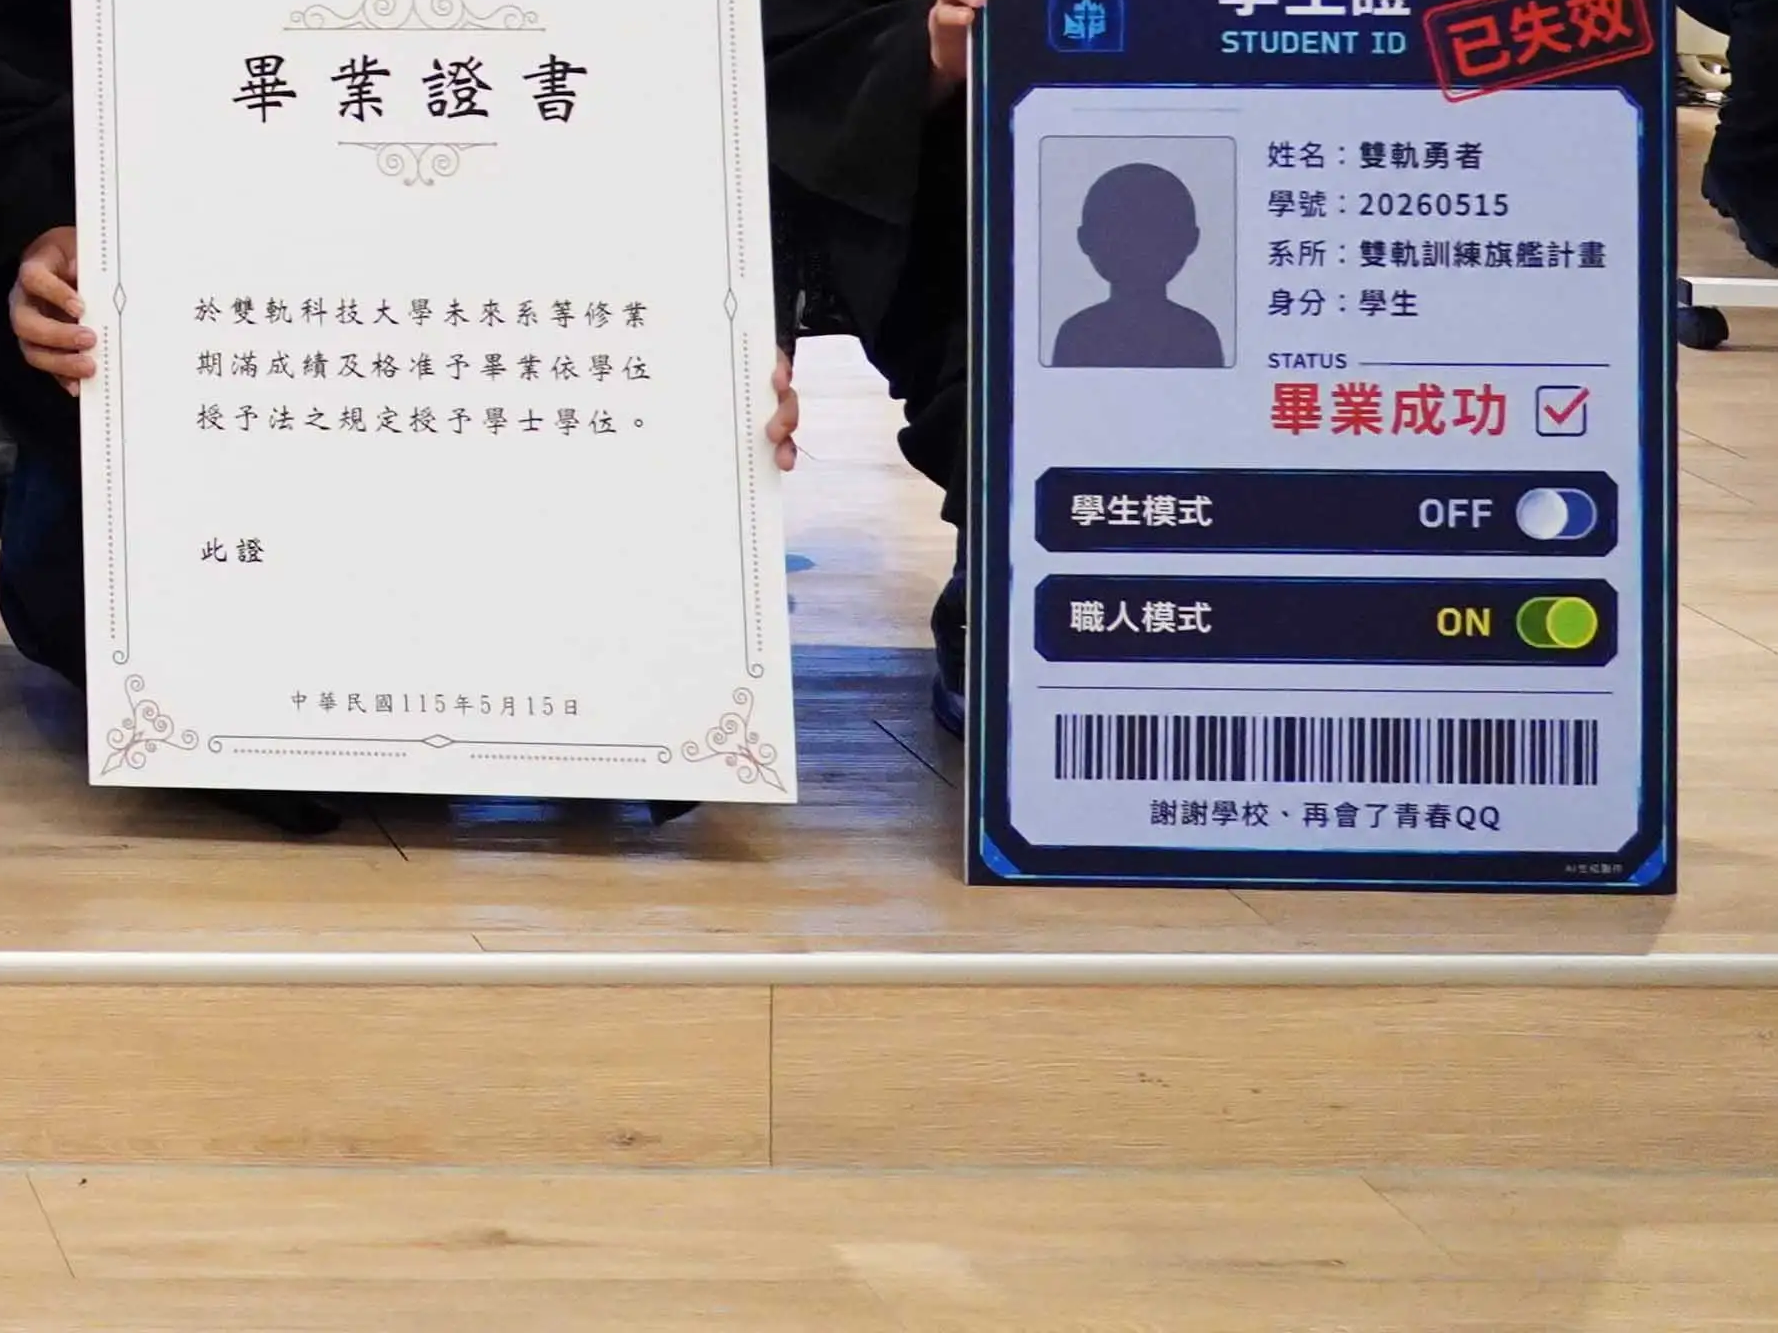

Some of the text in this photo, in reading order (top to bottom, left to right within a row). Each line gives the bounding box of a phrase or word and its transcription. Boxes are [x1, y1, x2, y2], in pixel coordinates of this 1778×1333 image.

[1221, 30, 1407, 55] STUDENT ID
[232, 53, 588, 124] 畢業證書
[1267, 141, 1483, 170] 姓名：雙軌勇者
[1267, 189, 1509, 218] 學號：20260515
[1268, 239, 1606, 269] 系所：雙軌訓練旗艦計畫
[194, 296, 648, 329] 於雙軌科技大學未來系等修業
[1268, 288, 1419, 317] 身分：學生
[196, 350, 651, 382] 期滿成績及格准予畢業依學位
[1268, 352, 1348, 370] STATUS
[196, 403, 644, 437] 授予法之規定授予學士學位。
[1270, 382, 1506, 436] 畢業成功
[1071, 494, 1213, 527] 學生模式
[1418, 498, 1493, 529] OFF
[200, 537, 265, 564] 此證
[1069, 600, 1212, 634] 職人模式
[1436, 607, 1491, 637] ON
[291, 690, 578, 717] 中華民國115年5月15日
[1150, 799, 1501, 832] 謝謝學校、再會了青春QQ
